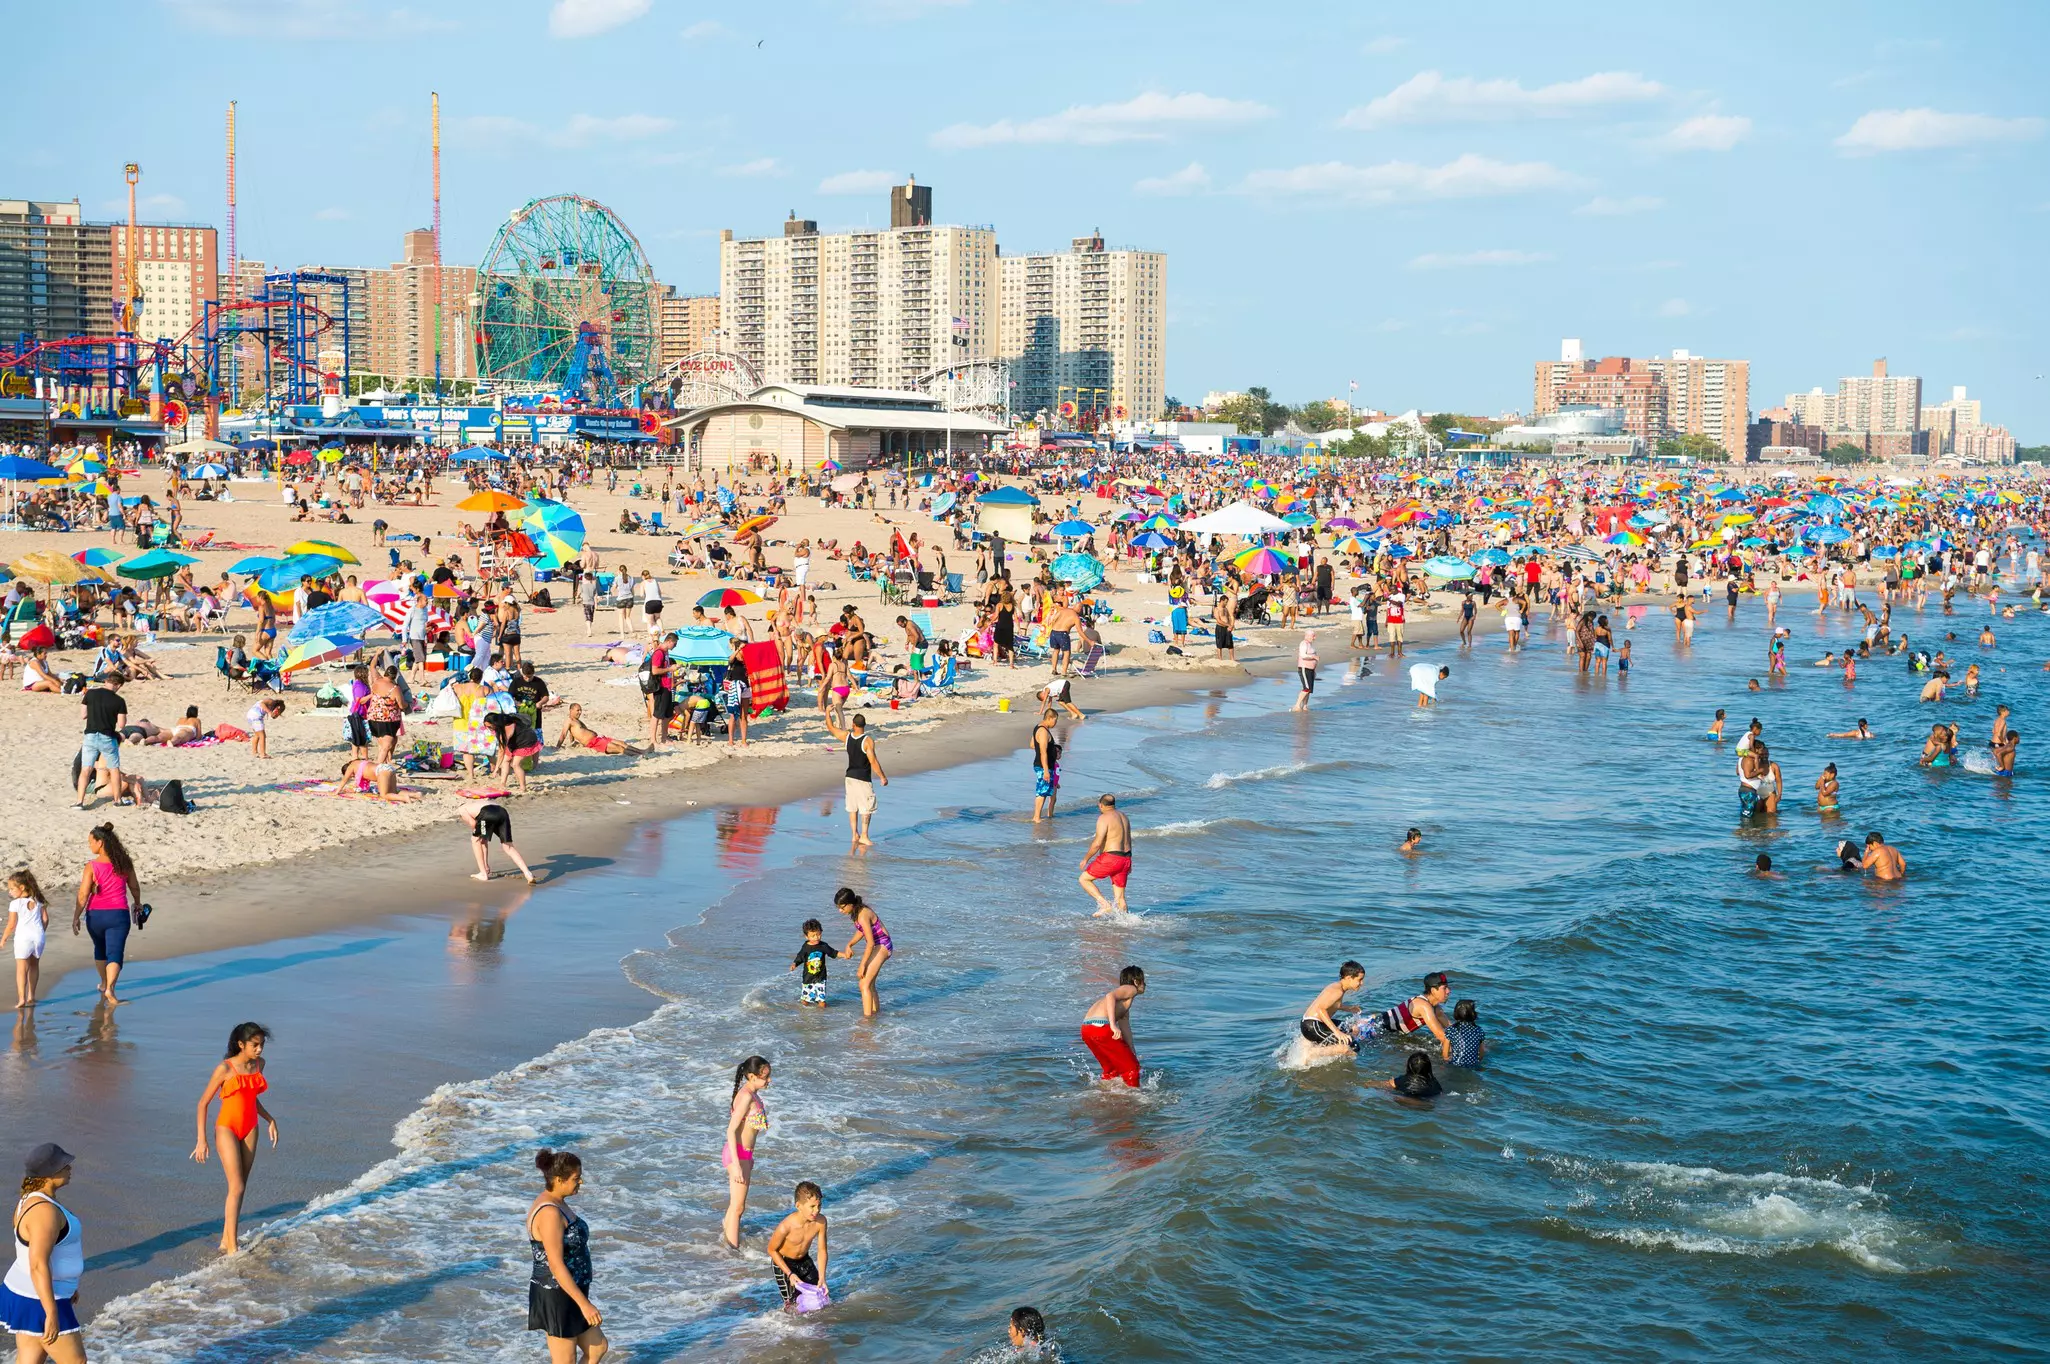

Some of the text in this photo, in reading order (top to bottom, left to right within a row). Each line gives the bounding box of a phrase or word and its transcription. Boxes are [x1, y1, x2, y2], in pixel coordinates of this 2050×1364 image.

[680, 360, 736, 371] CYCLONE
[382, 407, 469, 422] Tom's Coney Island
